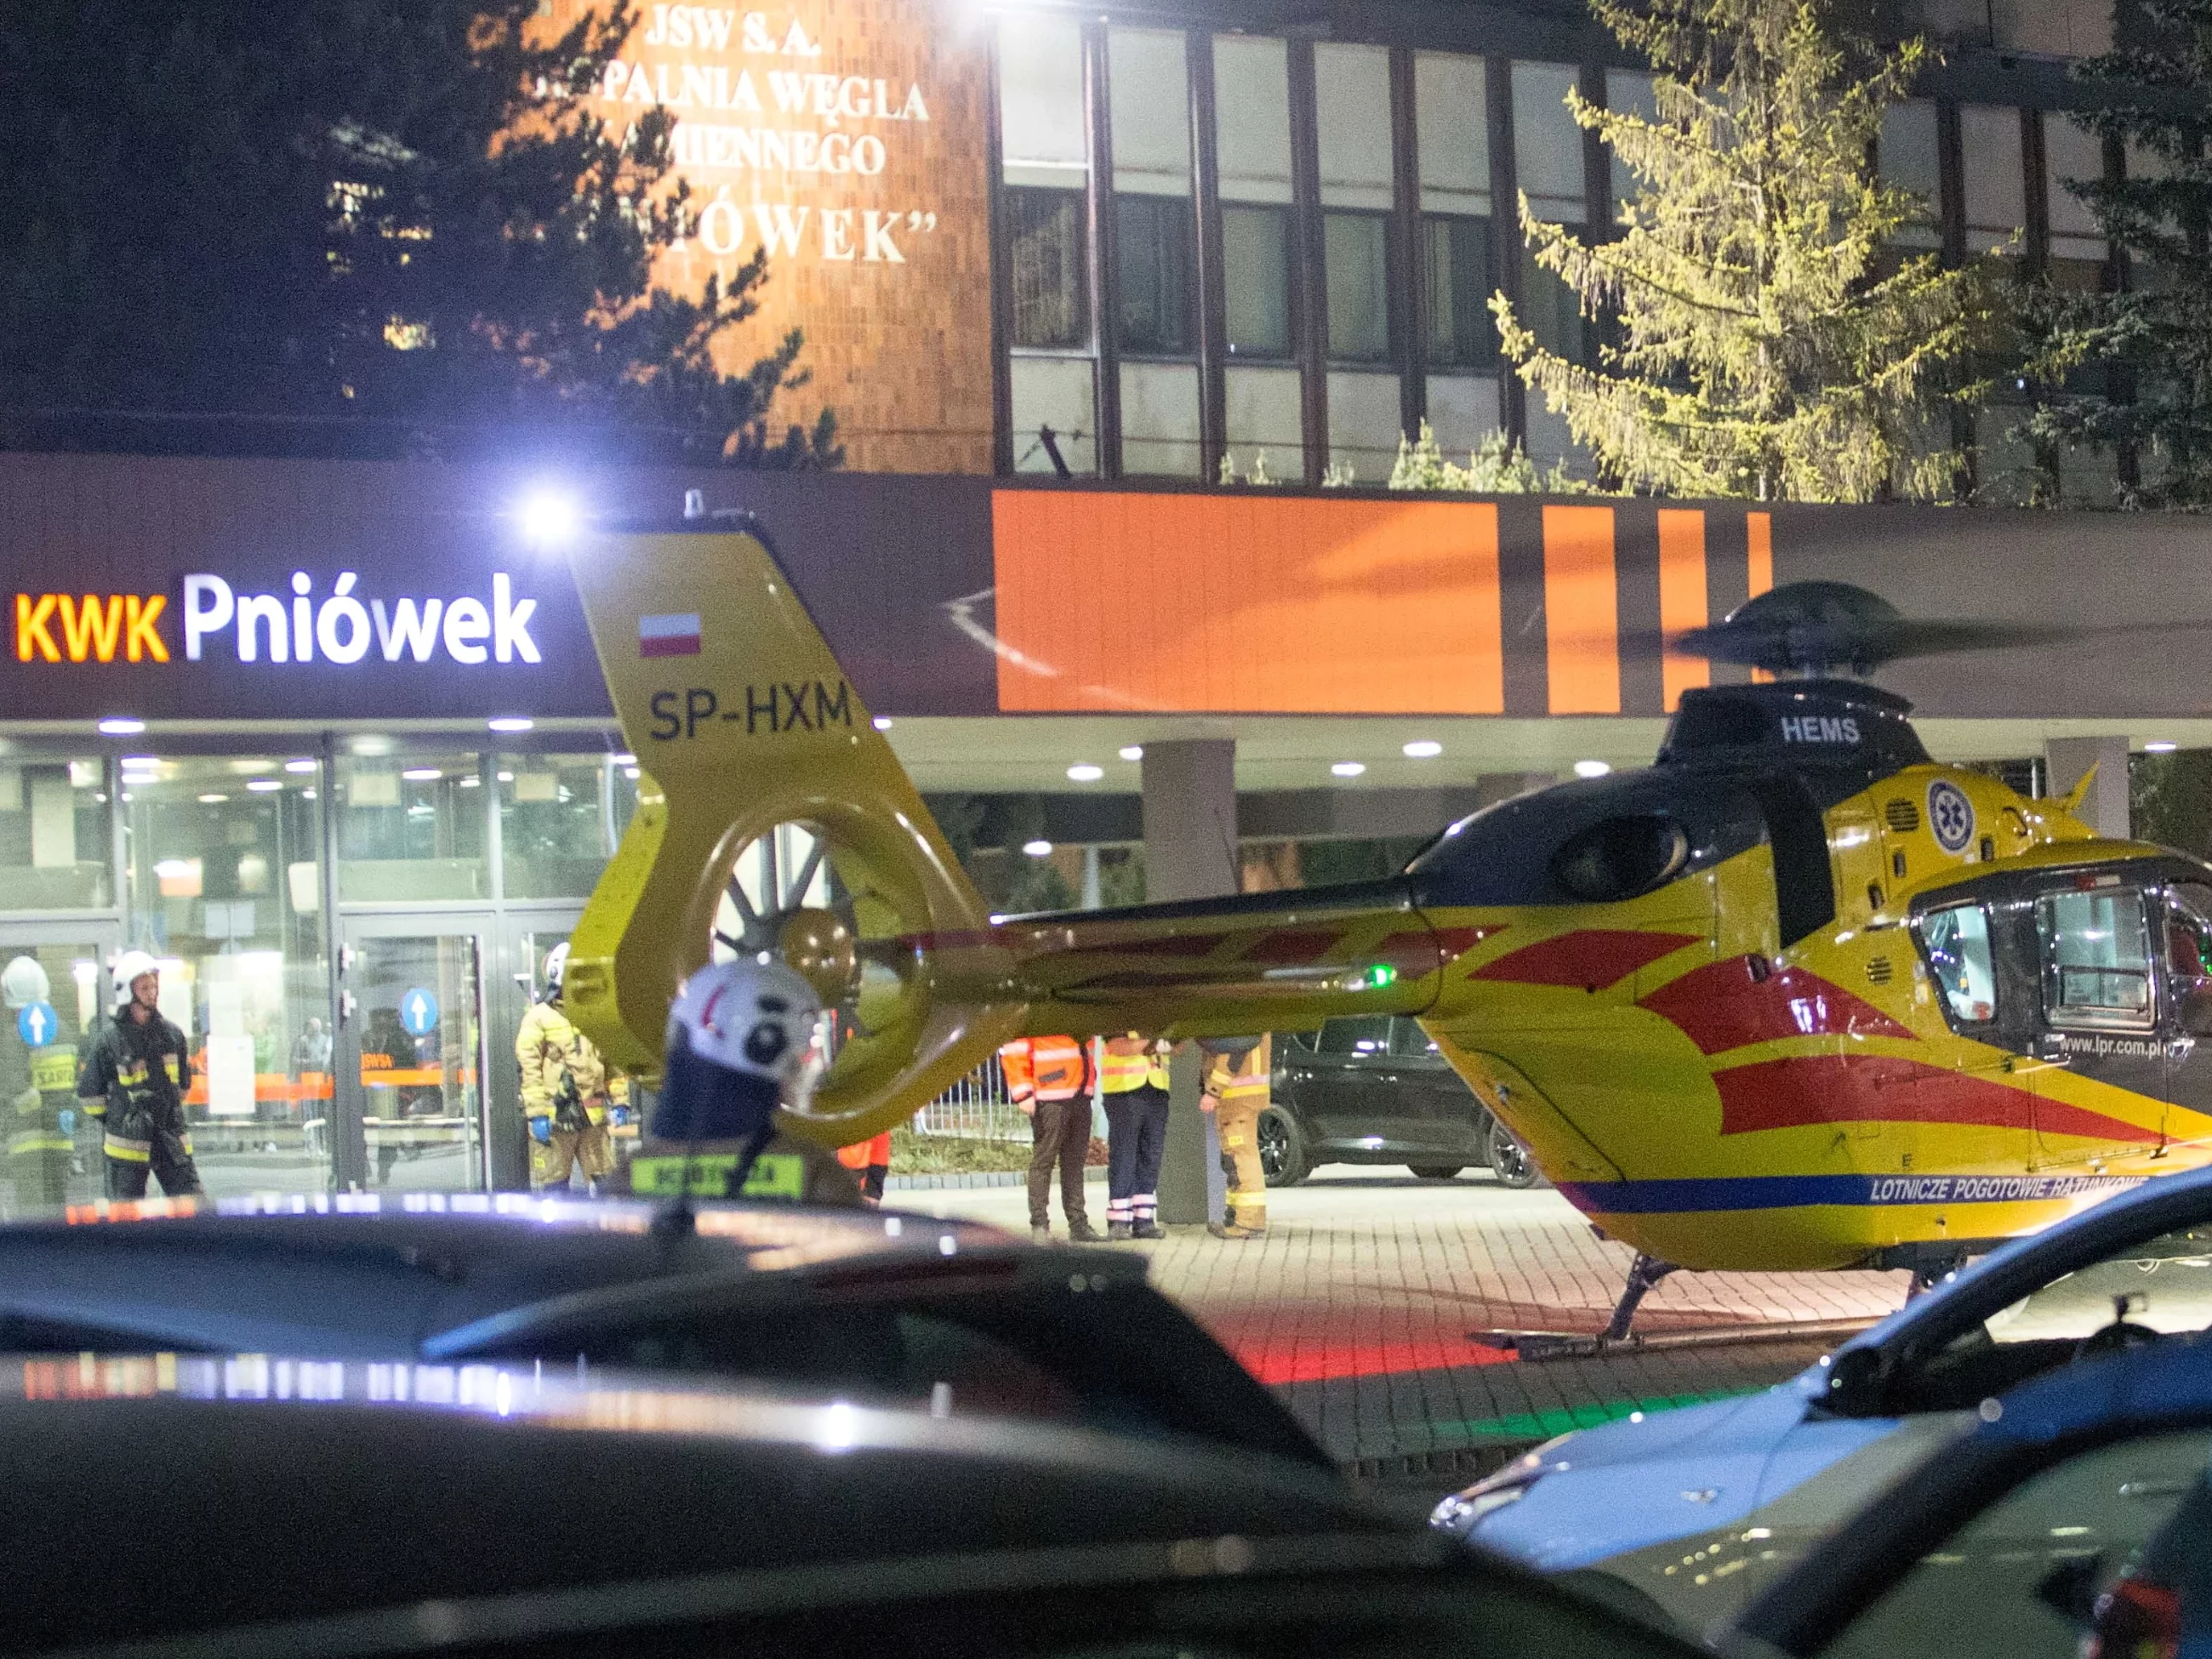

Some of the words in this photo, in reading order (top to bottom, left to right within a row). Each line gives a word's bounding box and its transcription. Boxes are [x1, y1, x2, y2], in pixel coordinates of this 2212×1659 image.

[644, 3, 734, 52] JSW
[743, 11, 776, 55] S.
[780, 18, 822, 57] A.
[534, 58, 762, 112] PALNIA
[767, 71, 931, 127] WĘGLA
[14, 594, 169, 663] KWK
[183, 571, 543, 664] Pniówek
[649, 681, 852, 742] SP-HXM
[1781, 715, 1861, 744] HEMS
[2060, 1035, 2162, 1061] www.lpr.com.pl
[1871, 1177, 1949, 1202] LOTNICZE
[1953, 1176, 2047, 1201] POGOTOWIE
